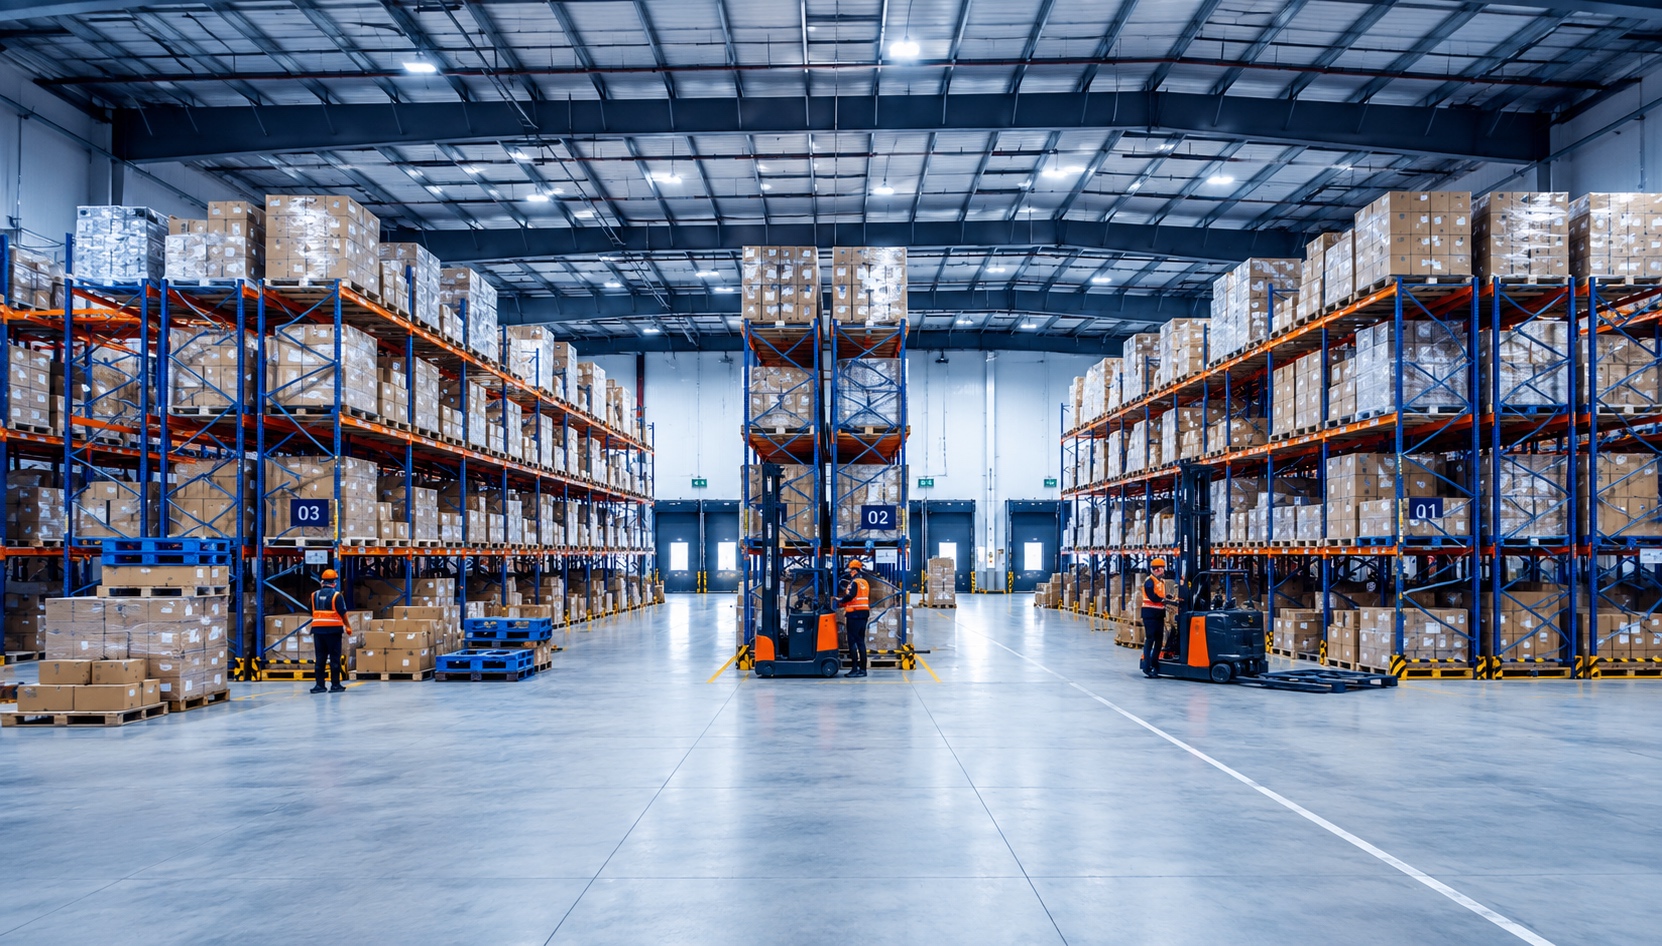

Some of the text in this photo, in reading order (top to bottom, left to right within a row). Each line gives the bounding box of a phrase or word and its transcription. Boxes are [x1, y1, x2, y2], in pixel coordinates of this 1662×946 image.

[298, 505, 320, 521] 03
[868, 510, 889, 525] 02
[1416, 503, 1436, 519] 01
